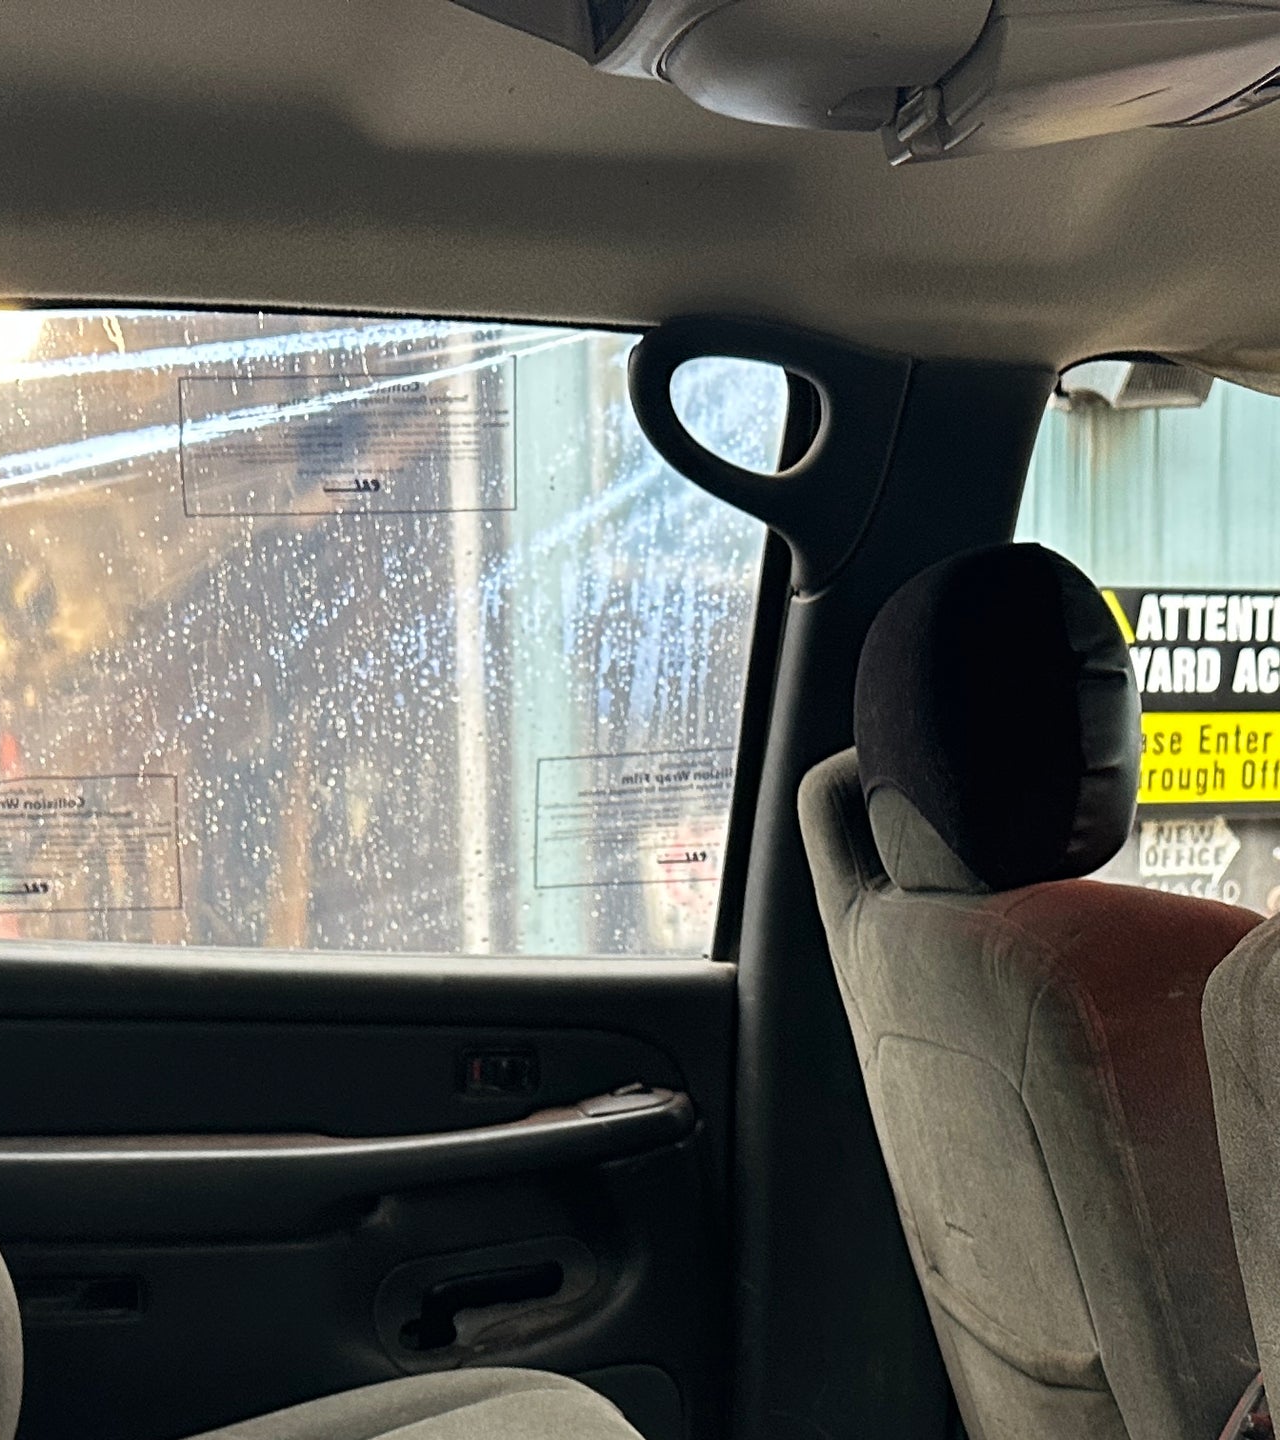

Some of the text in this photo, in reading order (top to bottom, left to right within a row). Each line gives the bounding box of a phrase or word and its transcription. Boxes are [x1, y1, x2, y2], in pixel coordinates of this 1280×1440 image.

[1129, 646, 1221, 693] YARD
[1199, 724, 1273, 755] Enter
[1138, 760, 1225, 796] rough
[1145, 845, 1227, 867] OFFICE
